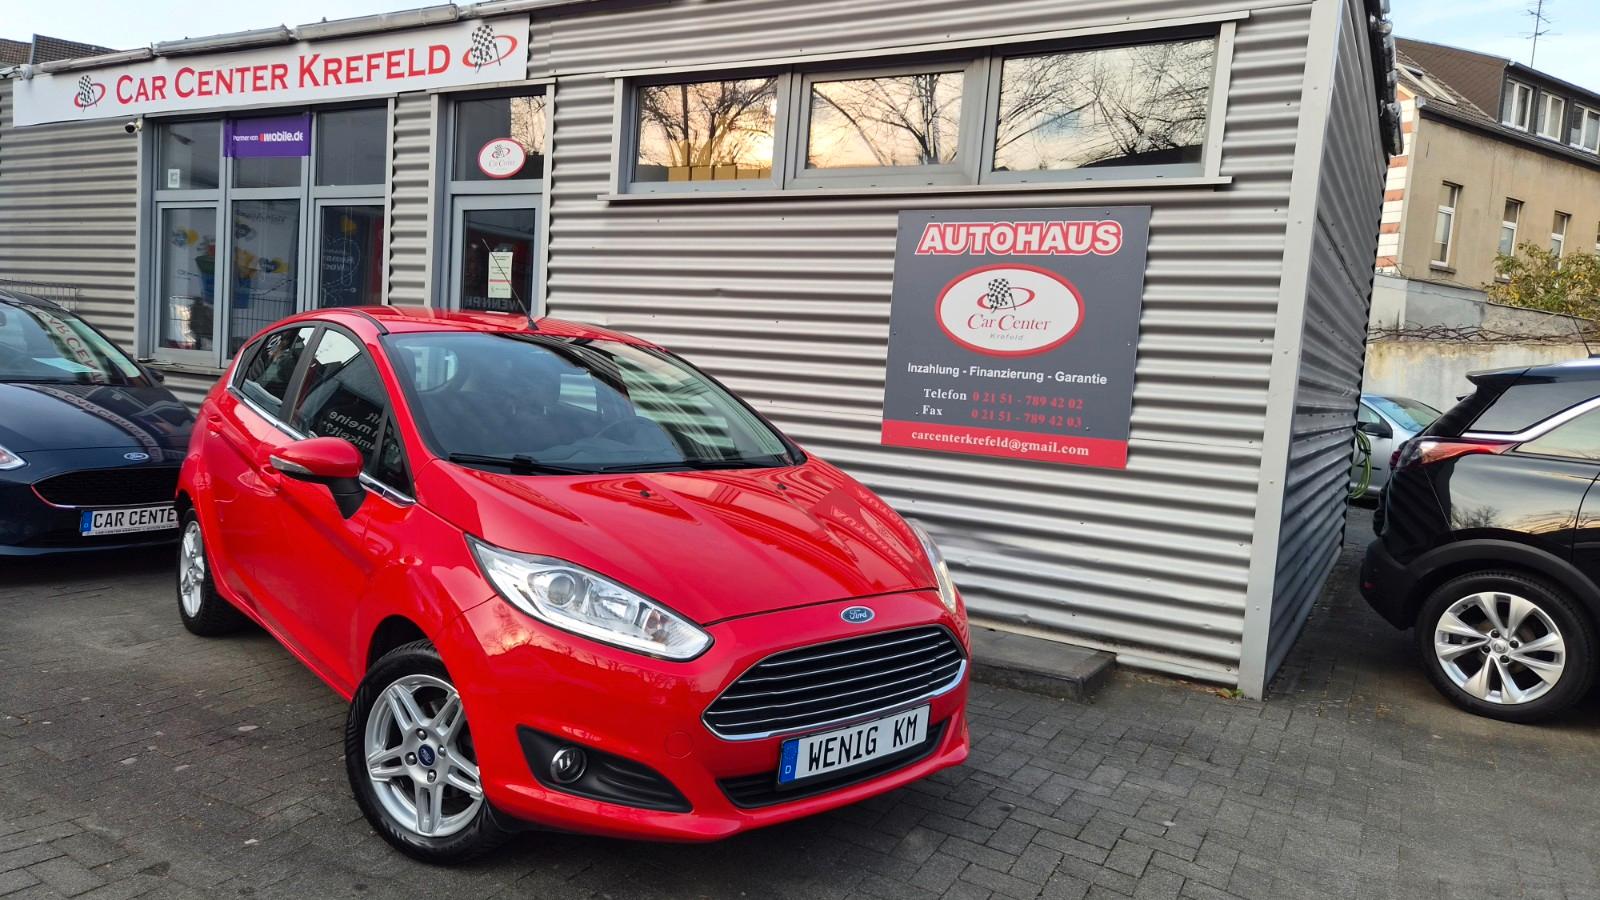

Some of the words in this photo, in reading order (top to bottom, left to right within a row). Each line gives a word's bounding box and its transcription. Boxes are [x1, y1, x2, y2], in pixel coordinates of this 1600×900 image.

[117, 74, 167, 104] CAR
[174, 63, 289, 98] CENTER
[299, 44, 450, 88] KREFELD
[915, 220, 1123, 256] AUTOHAUS
[968, 313, 996, 330] Car
[998, 315, 1052, 331] Center
[907, 362, 960, 378] Inzahlung
[970, 366, 1044, 383] Finanzierung
[1055, 371, 1107, 385] Garantie
[924, 388, 967, 401] Telefon
[973, 392, 980, 401] 0
[983, 393, 996, 404] 21
[1000, 394, 1013, 405] 51
[1025, 395, 1048, 407] 789
[1051, 397, 1065, 409] 42
[1068, 399, 1084, 410] 02
[922, 404, 943, 416] Fax
[971, 409, 978, 418] 0
[982, 410, 994, 421] 21
[999, 411, 1011, 422] 51
[1050, 415, 1063, 427] 42
[912, 430, 1089, 456] carcenterkrefeld@gmail.com
[93, 511, 125, 529] CAR
[129, 507, 177, 526] CENTE
[808, 725, 879, 772] WENIG
[892, 713, 918, 748] KM
[785, 764, 791, 774] D
